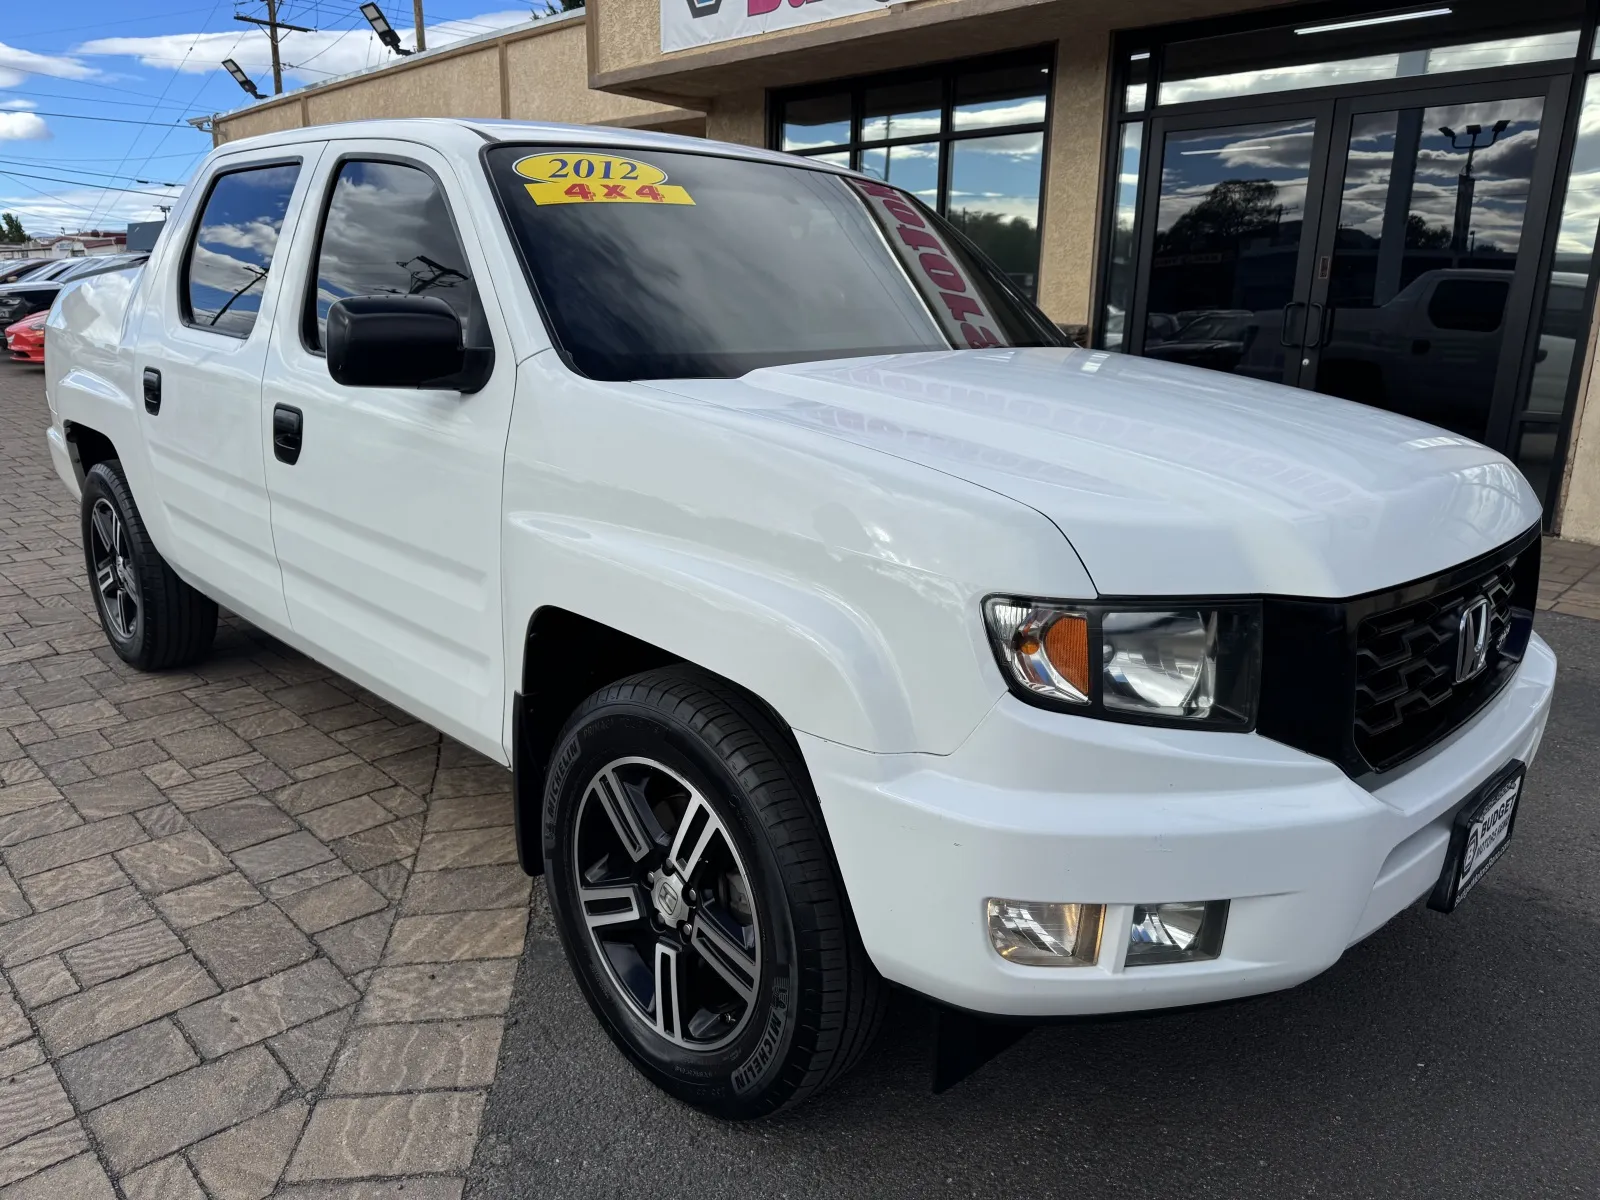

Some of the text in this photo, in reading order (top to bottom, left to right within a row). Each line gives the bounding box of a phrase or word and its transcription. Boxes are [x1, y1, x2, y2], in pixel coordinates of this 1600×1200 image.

[548, 158, 639, 180] 2012
[547, 739, 578, 817] MICHELIN
[734, 1012, 782, 1090] MICHELIN
